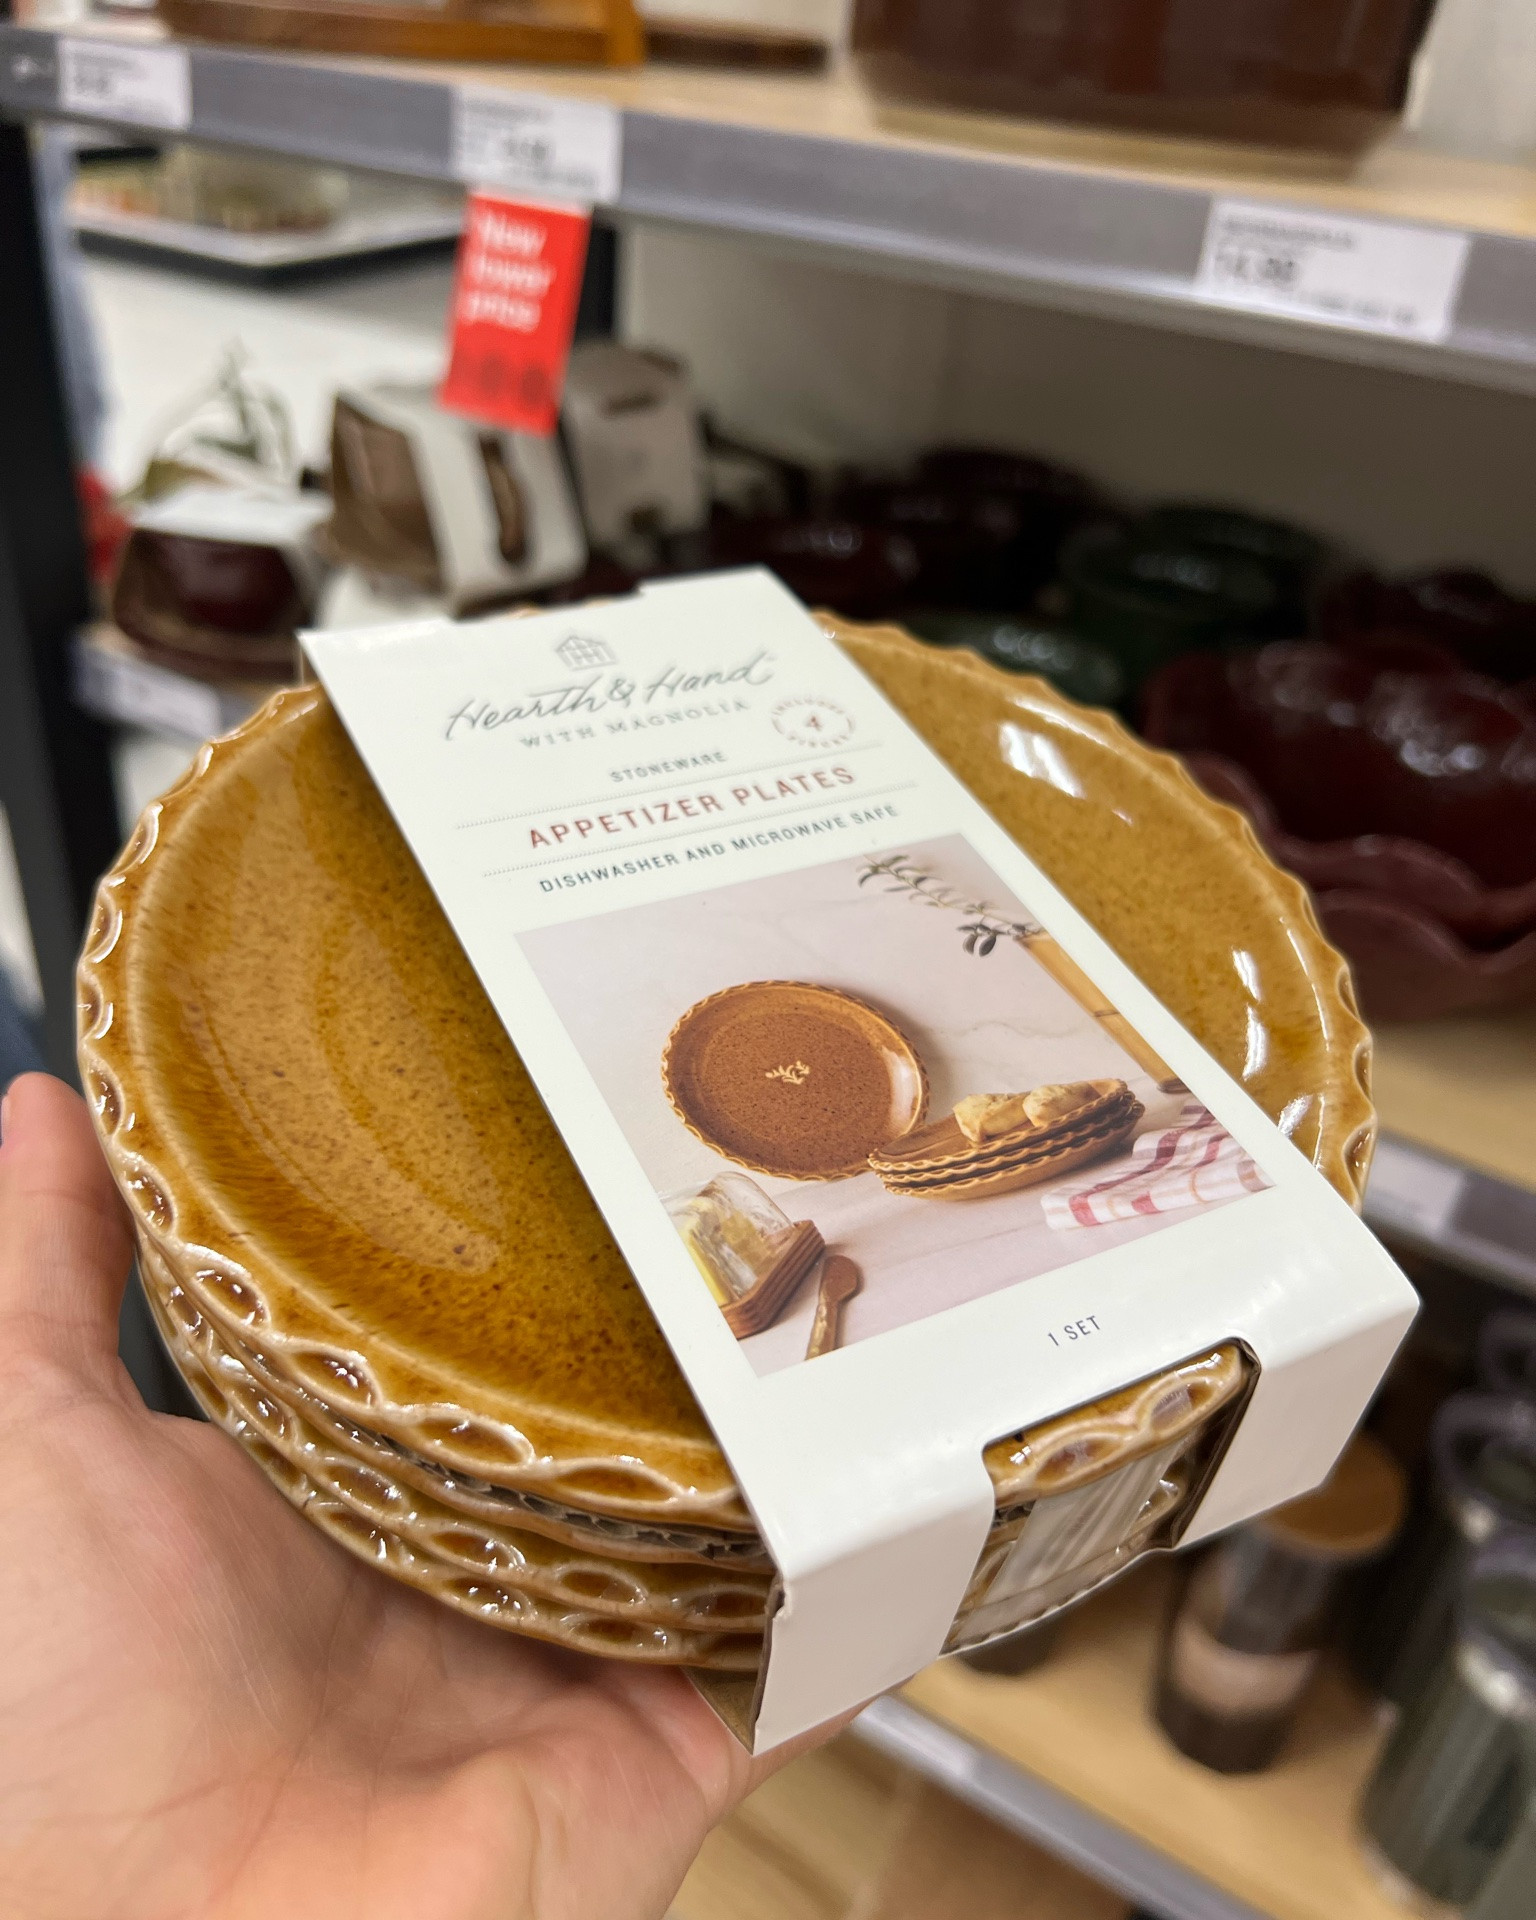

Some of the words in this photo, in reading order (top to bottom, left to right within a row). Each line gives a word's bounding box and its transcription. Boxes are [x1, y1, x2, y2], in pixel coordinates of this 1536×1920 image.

[444, 674, 606, 741] Hearth
[608, 677, 636, 708] &
[643, 650, 774, 704] Hand
[519, 725, 596, 748] WITH
[605, 699, 750, 735] MAGNOLIA
[609, 751, 728, 783] STONEWARE
[528, 794, 725, 850] APPETIZER
[731, 765, 857, 807] PLATES
[539, 852, 681, 893] DISHWASHER
[686, 841, 727, 864] AND
[731, 815, 848, 852] MICROWAVE
[852, 804, 900, 826] SAFE
[1047, 1332, 1060, 1347] 1
[1063, 1314, 1101, 1341] SET
